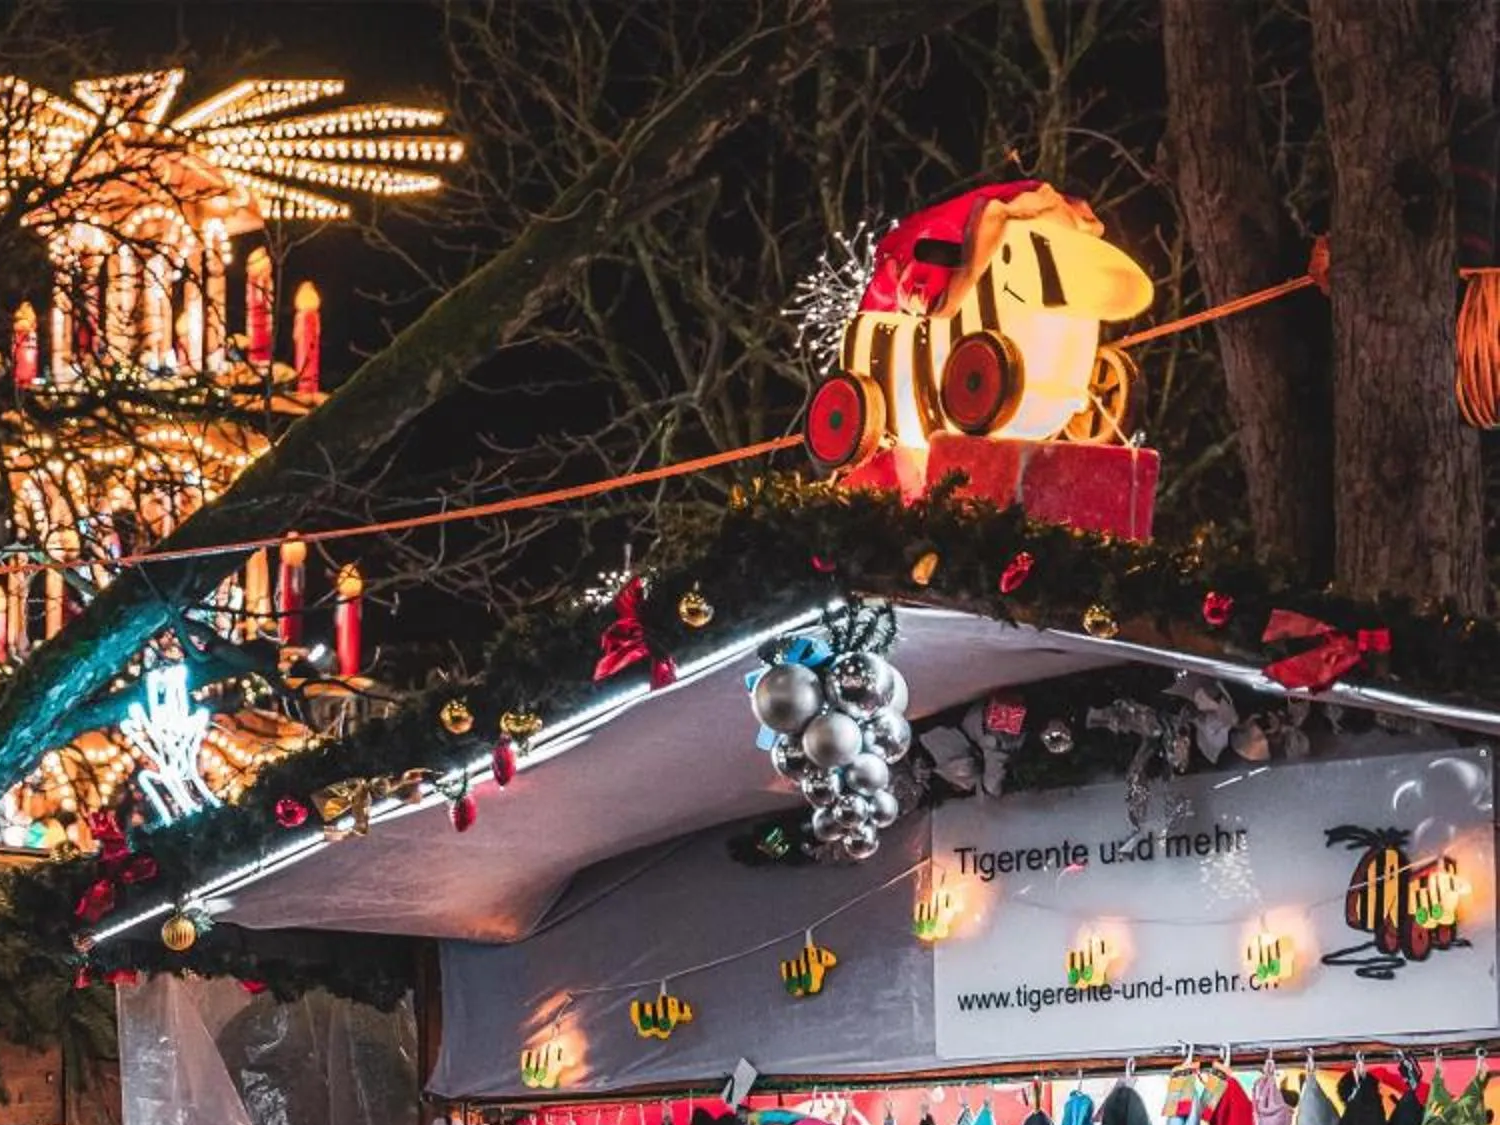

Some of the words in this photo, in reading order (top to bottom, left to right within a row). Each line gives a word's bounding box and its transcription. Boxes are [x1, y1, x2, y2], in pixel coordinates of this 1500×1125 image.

[953, 840, 1090, 883] Tigerente
[1165, 823, 1248, 859] mehr
[957, 970, 1280, 1013] www.tigerente-und-mehr.c
